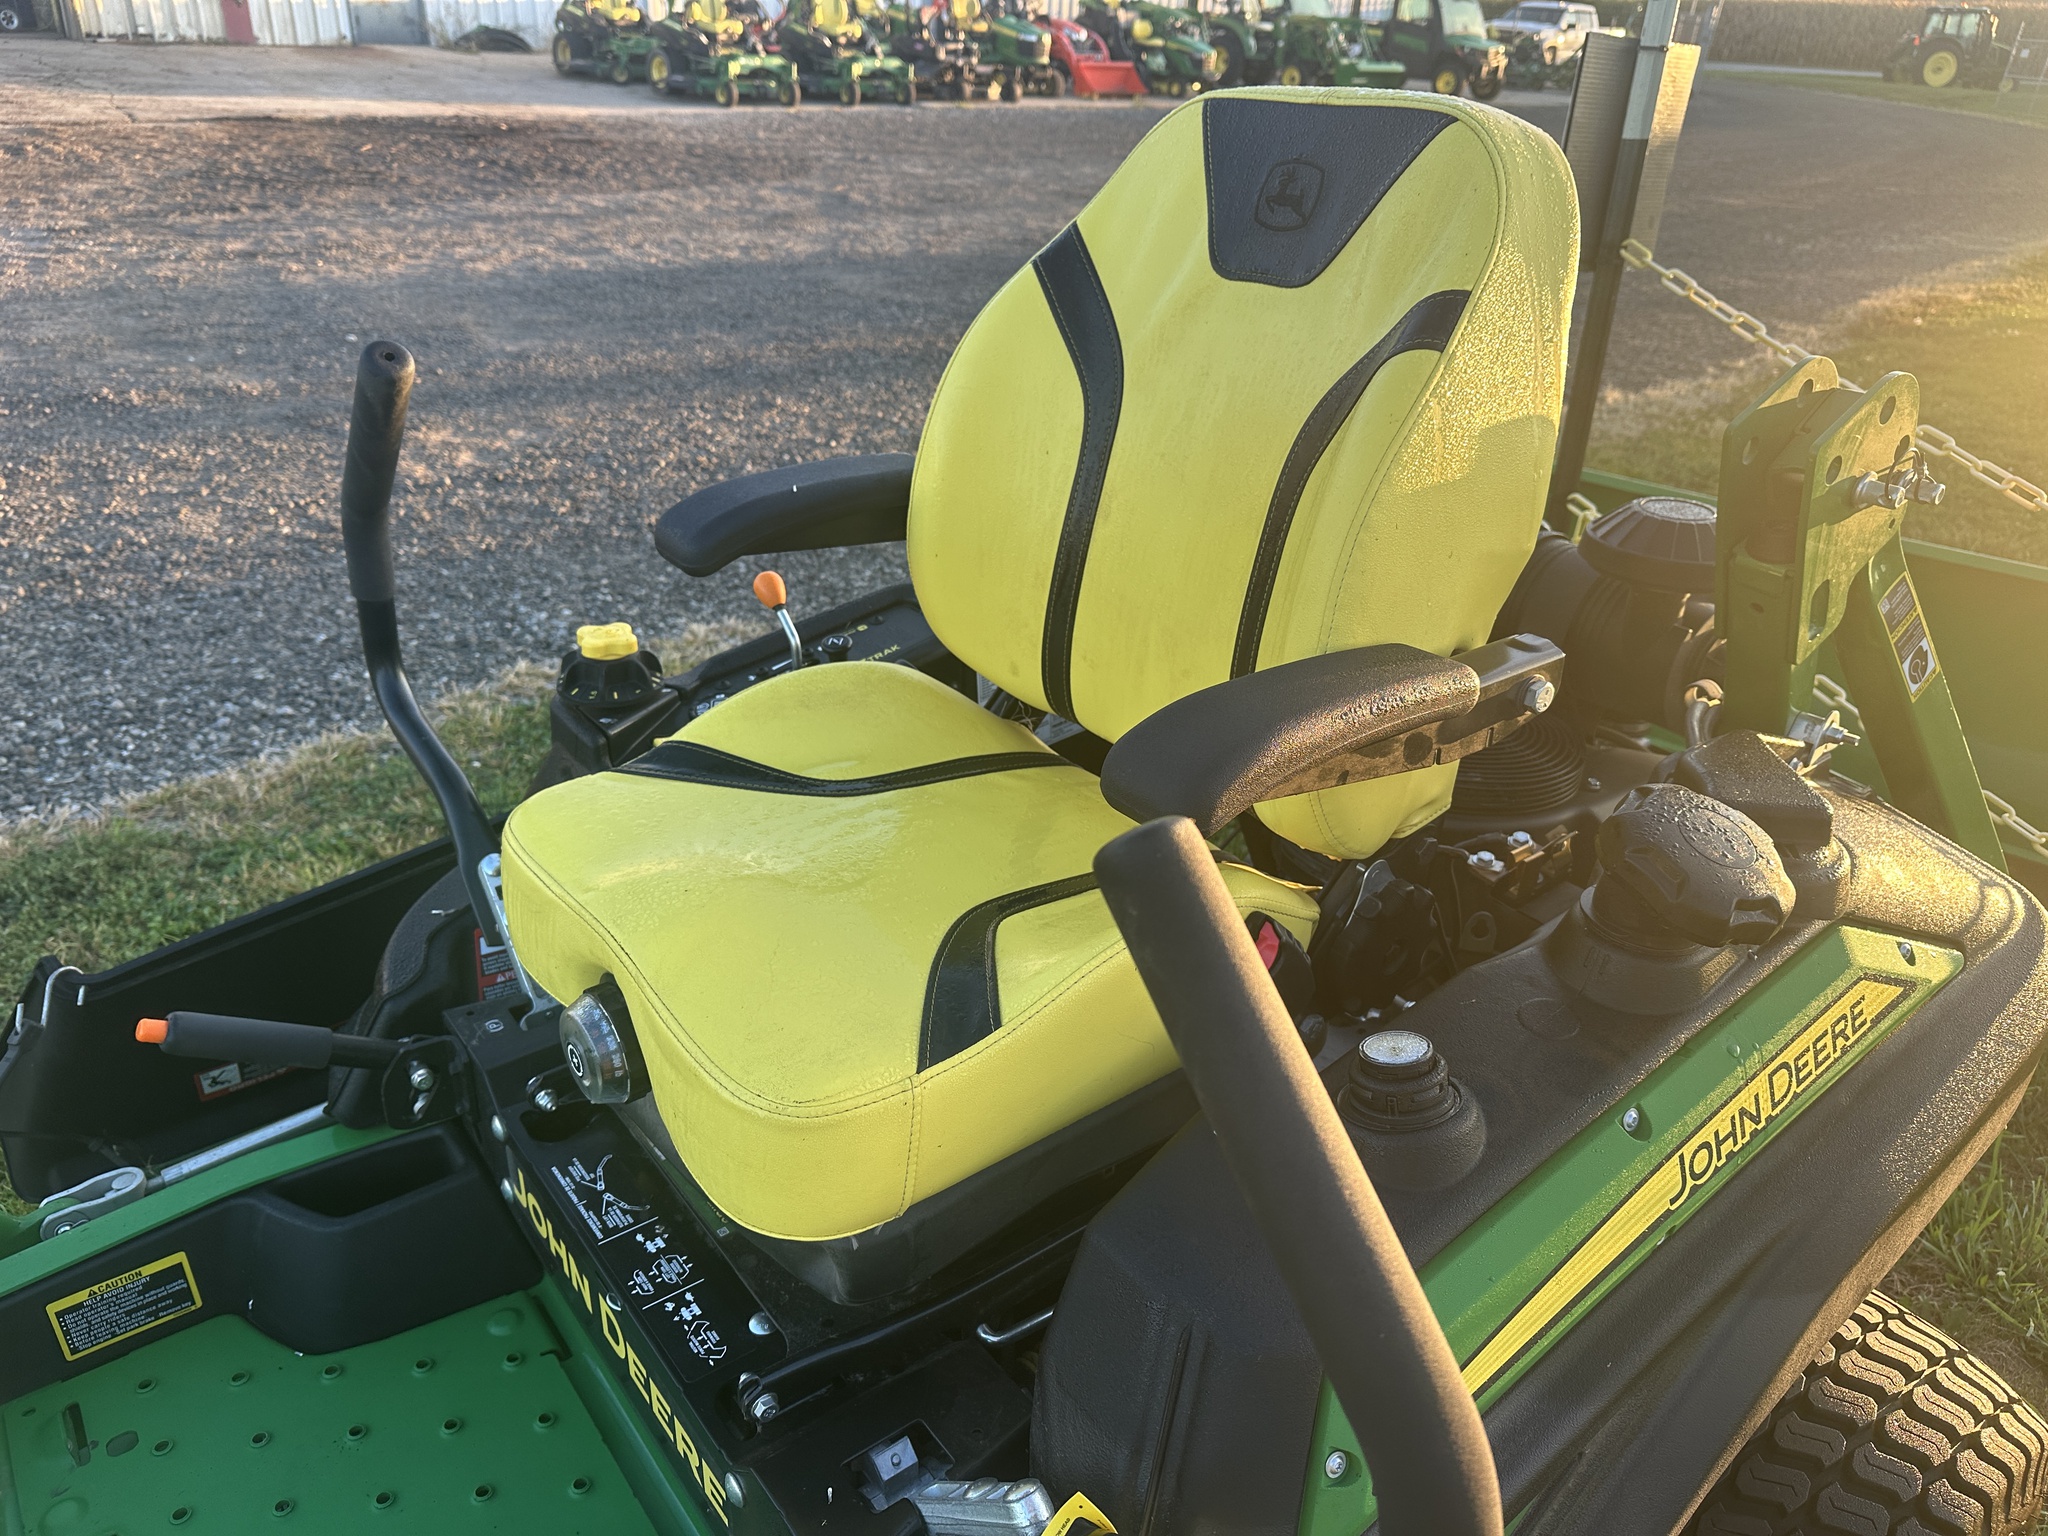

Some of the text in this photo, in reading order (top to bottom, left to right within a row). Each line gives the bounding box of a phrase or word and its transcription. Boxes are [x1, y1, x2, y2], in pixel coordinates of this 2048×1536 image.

[860, 644, 901, 662] TRAK
[1669, 995, 1868, 1207] JOHN DEERE
[83, 1276, 151, 1306] HELP AVOID INJURY
[98, 1271, 142, 1293] CAUTION
[64, 1285, 143, 1320] Operator training required
[131, 1306, 156, 1318] distance
[71, 1328, 89, 1337] Never
[514, 1168, 729, 1528] JOHN DEERE
[1061, 1518, 1071, 1530] HEAD
